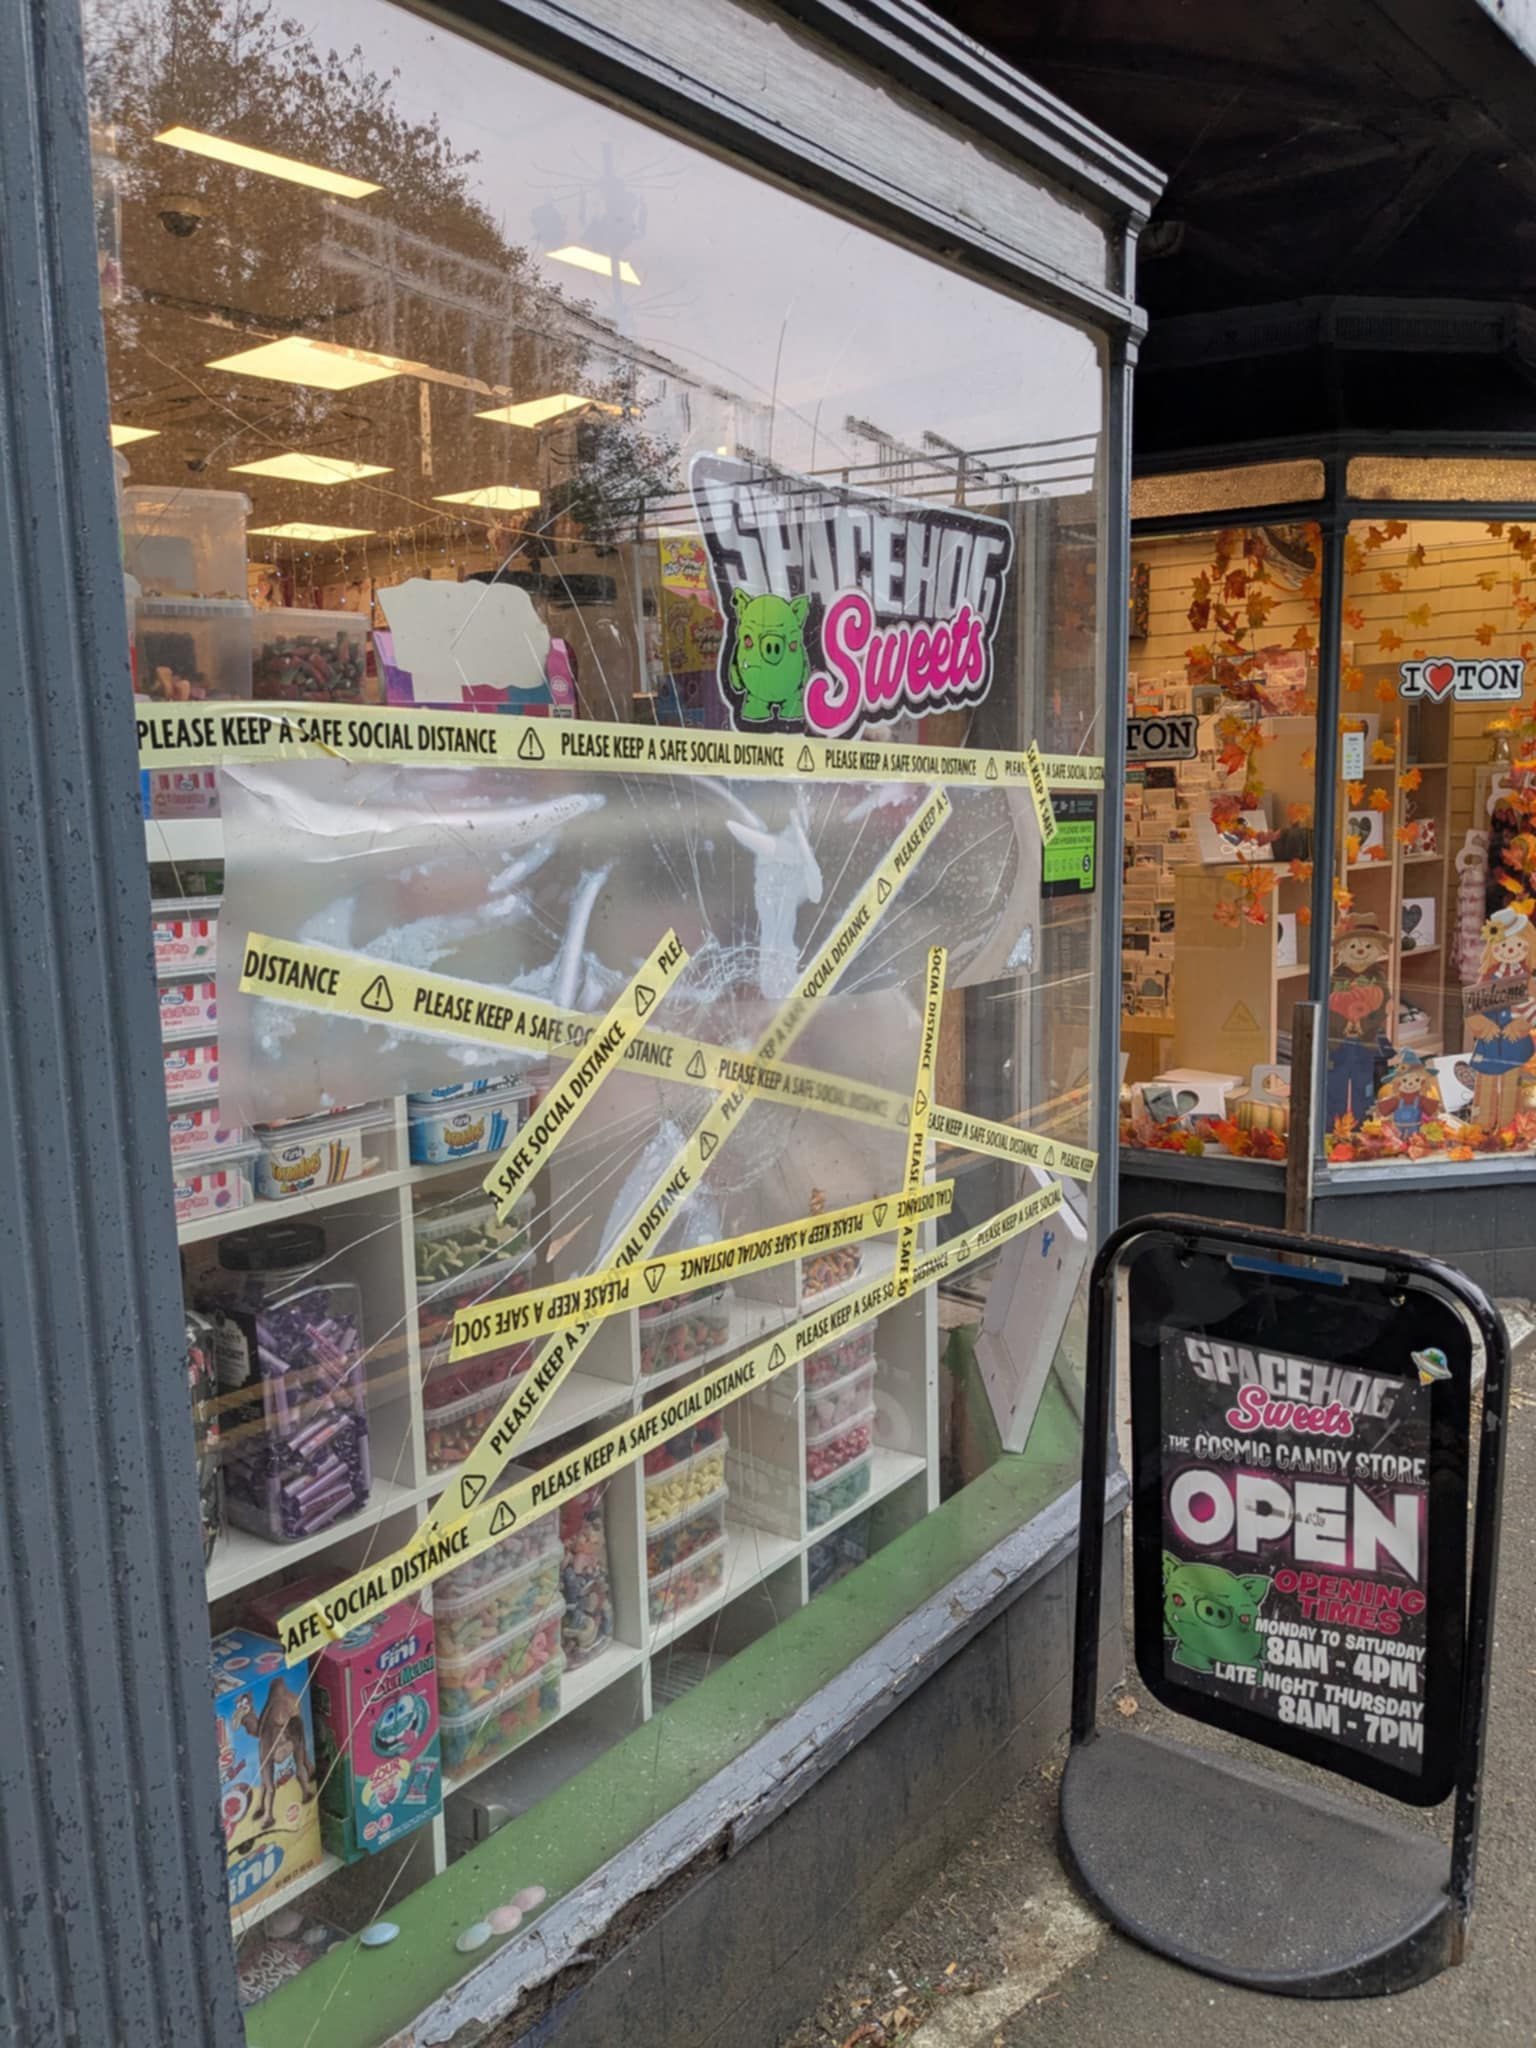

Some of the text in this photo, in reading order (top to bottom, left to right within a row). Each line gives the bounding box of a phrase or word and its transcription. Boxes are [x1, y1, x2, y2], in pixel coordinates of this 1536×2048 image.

[698, 475, 1005, 625] SPACEHOG
[806, 594, 985, 732] Sweets
[1404, 664, 1520, 691] I TON
[137, 717, 497, 755] PLEASE KEEP A SAFE SOCIAL DISTANCE
[561, 732, 784, 767] PLEASE KEEP A SAFE SOCIAL DISTANCE
[1126, 722, 1193, 750] TON
[825, 748, 976, 776] PLEASE KEEP A SAFE SOCIAL DISTANCE
[893, 799, 945, 873] PLEASE KEEP A
[244, 950, 340, 996] DISTANCE
[803, 961, 835, 998] SOCIAL
[831, 904, 871, 963] DISTANCE
[414, 988, 473, 1024] PLEASE
[475, 1001, 515, 1031] KEEP
[514, 1011, 526, 1035] A
[529, 1014, 564, 1043] SAFE
[922, 947, 942, 1070] SOCIAL DISTANCE
[718, 1058, 757, 1086] PLEASE
[757, 1067, 783, 1090] KEEP
[782, 1074, 791, 1093] A
[498, 1147, 534, 1196] SAFE
[528, 1094, 575, 1155] SOCIAL
[570, 1020, 626, 1098] DISTANCE
[908, 1133, 923, 1184] PLEASE
[928, 1112, 1038, 1159] EASE KEEP A SAFE SOCIAL DISTANCE
[1060, 1151, 1094, 1173] PLEASE KEEP
[638, 1166, 691, 1241] DISTANCE
[897, 1192, 935, 1219] DISTANCE
[680, 1215, 864, 1281] PLEASE KEEP A SAFE SOCIAL DISTANCE
[977, 1223, 1001, 1248] PLEASE
[1001, 1213, 1018, 1234] KEEP
[899, 1240, 912, 1274] SAFE
[535, 1301, 545, 1324] A
[548, 1293, 583, 1321] KEEP
[584, 1278, 630, 1311] PLEASE
[496, 1304, 532, 1336] SAFE
[796, 1317, 829, 1350] PLEASE
[830, 1305, 851, 1331] KEEP
[853, 1300, 861, 1316] A
[862, 1291, 883, 1315] SAFE
[490, 1331, 580, 1455] PLEASE KEEP A
[1184, 1336, 1403, 1418] SPACEHOG
[531, 1361, 756, 1507] PLEASE KEEP A SAFE SOCIAL DISTANCE
[1226, 1384, 1355, 1437] Sweets
[1168, 1434, 1427, 1484] THE COSMIC CANDY STORE
[1169, 1469, 1420, 1582] OPEN
[324, 1579, 387, 1630] SOCIAL
[391, 1526, 469, 1591] DISTANCE
[1273, 1568, 1426, 1615] OPENING
[1255, 1617, 1426, 1663] MONDAY TO SATURDAY
[1299, 1596, 1402, 1635] TIMES
[380, 1634, 417, 1670] Fini
[1266, 1636, 1328, 1675] 8AM
[1353, 1653, 1418, 1693] 4PM
[1215, 1661, 1425, 1722] LATE NIGHT THURSDAY
[1277, 1695, 1340, 1735] 8AM
[1366, 1714, 1424, 1754] 7PM
